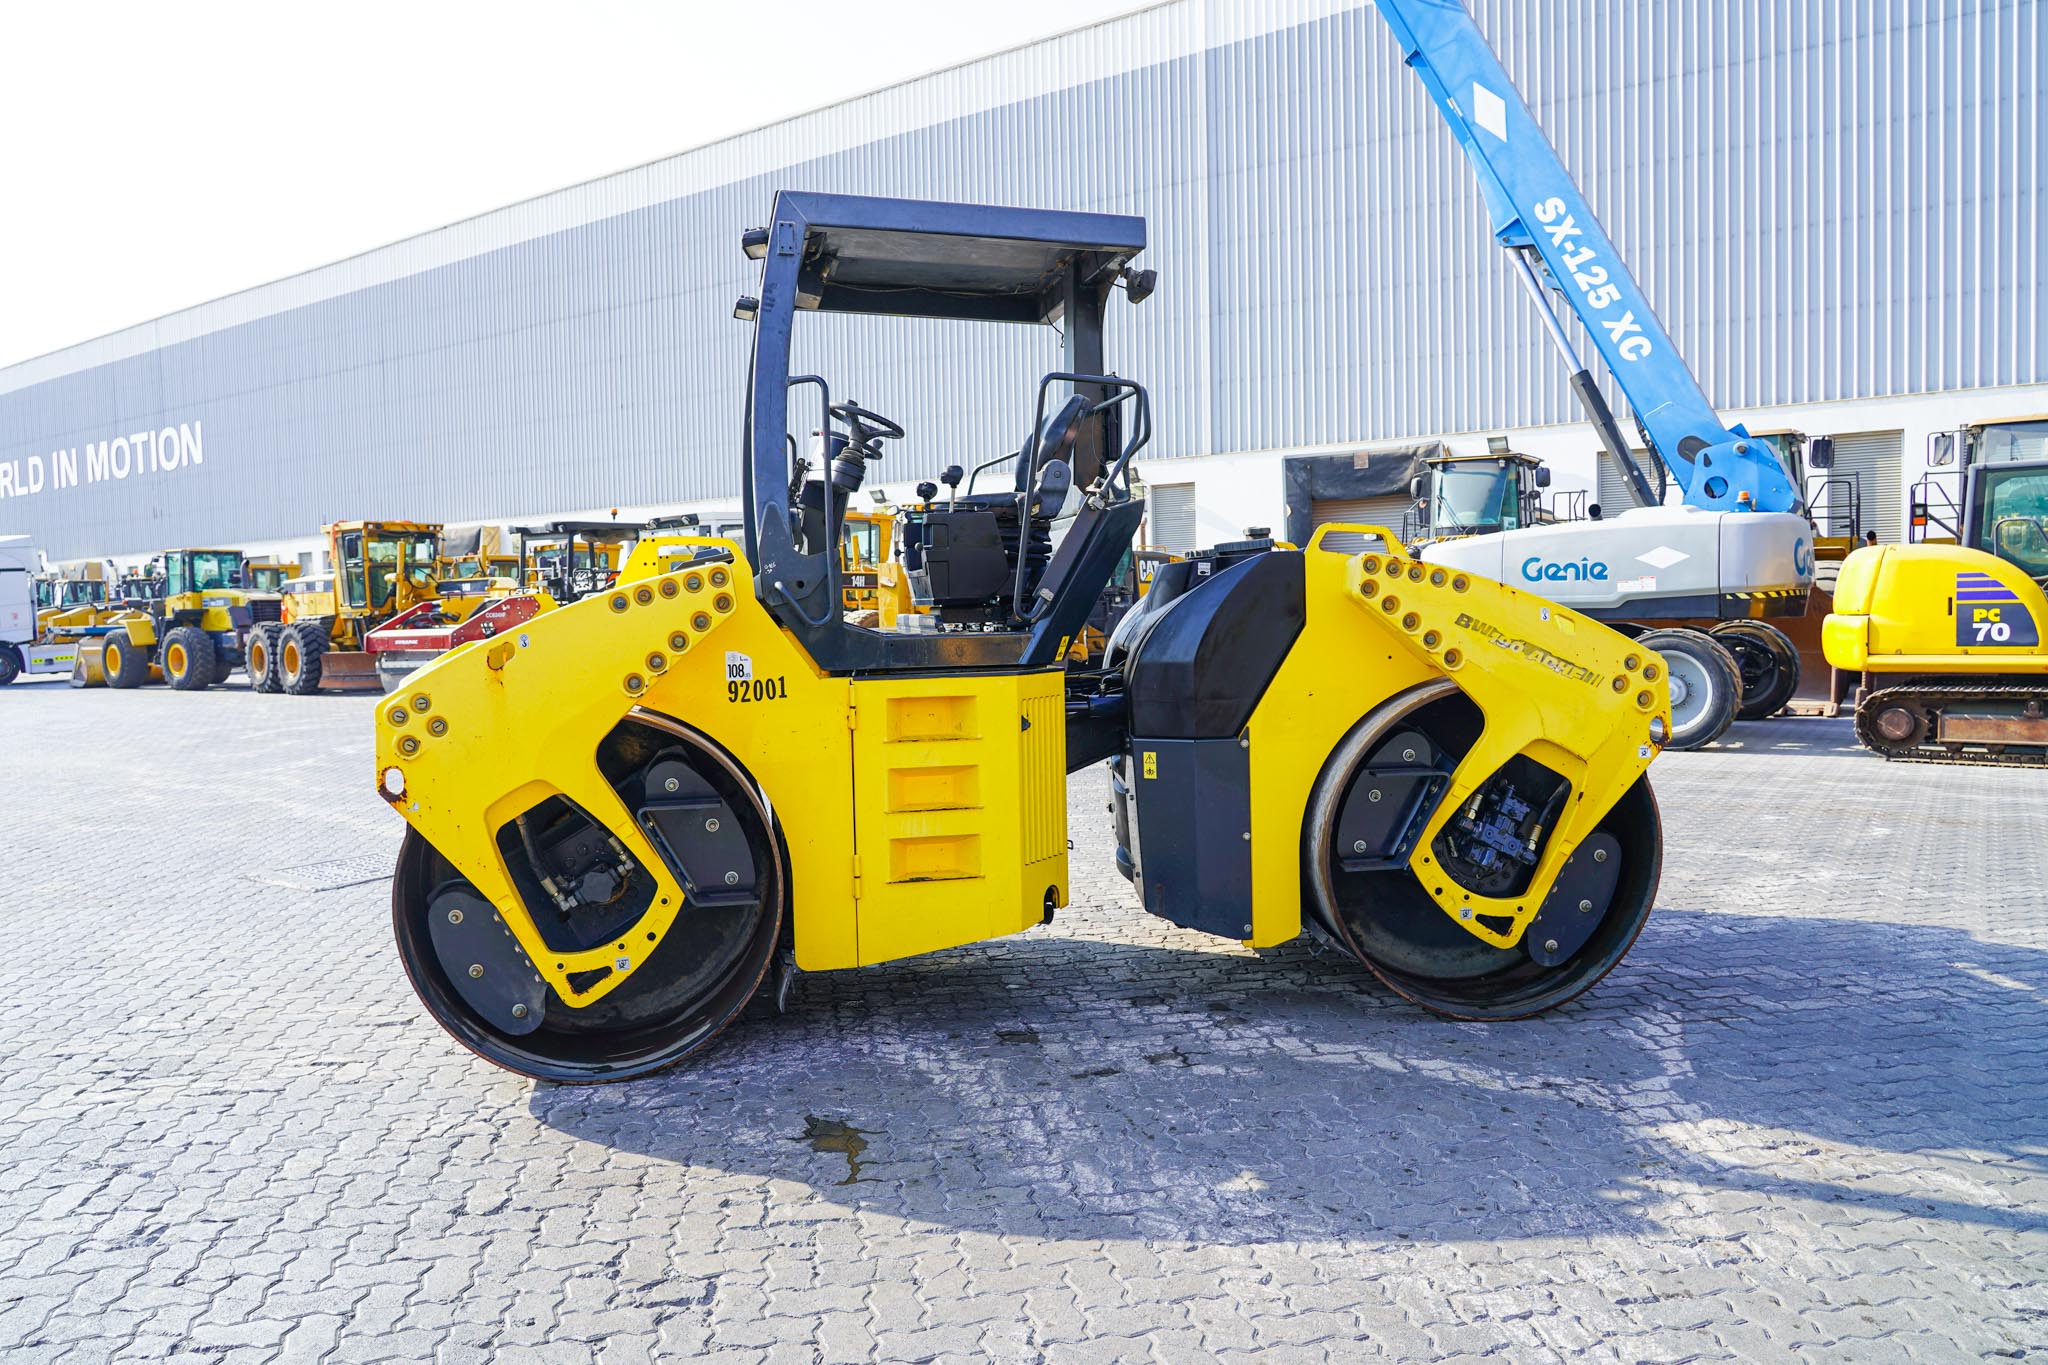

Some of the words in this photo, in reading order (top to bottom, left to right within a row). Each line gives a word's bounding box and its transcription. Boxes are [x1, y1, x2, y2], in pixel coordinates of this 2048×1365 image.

[1534, 196, 1622, 310] SX-125
[1601, 309, 1653, 362] XC
[52, 448, 78, 490] IN
[86, 420, 203, 484] MOTION
[1521, 556, 1608, 582] Genie
[851, 575, 866, 587] 14H
[1973, 608, 2001, 622] PC
[1972, 622, 2011, 642] 70
[727, 663, 745, 679] 108
[727, 675, 788, 703] 92001
